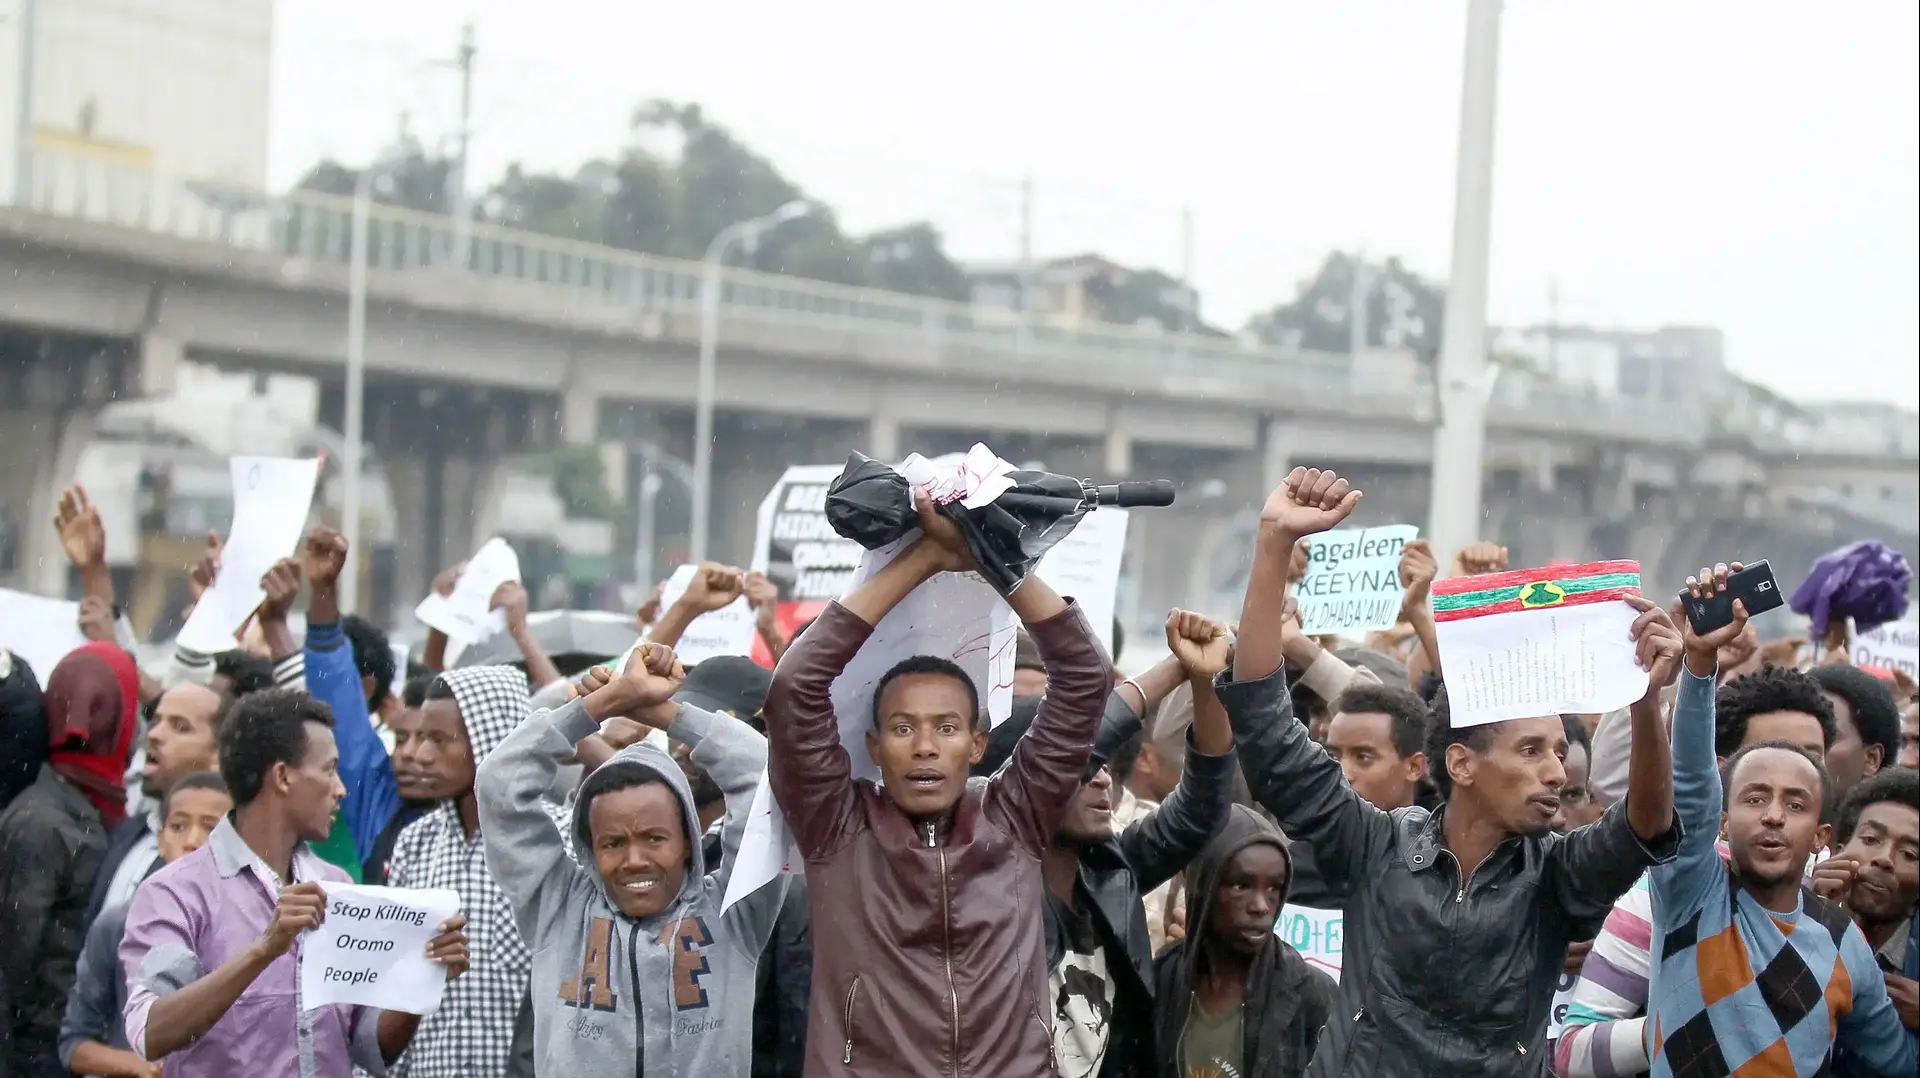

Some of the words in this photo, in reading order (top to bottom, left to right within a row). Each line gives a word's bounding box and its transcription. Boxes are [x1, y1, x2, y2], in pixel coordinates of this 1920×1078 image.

[1297, 570, 1398, 597] KEEYNA
[331, 901, 371, 921] Stop
[374, 904, 427, 927] Killing
[336, 934, 394, 952] Oromo
[324, 966, 378, 986] People
[676, 1015, 725, 1039] Fashio
